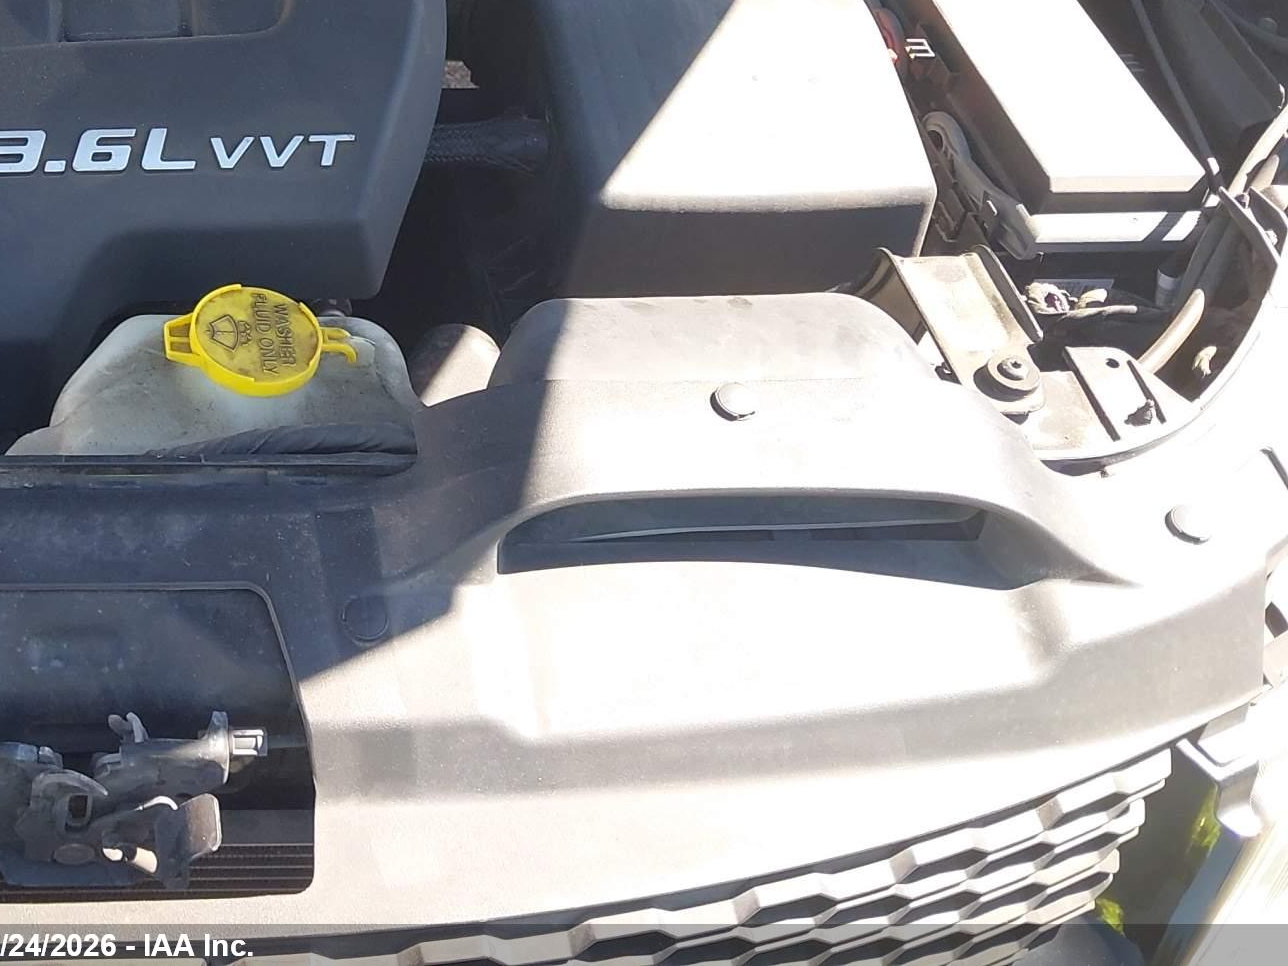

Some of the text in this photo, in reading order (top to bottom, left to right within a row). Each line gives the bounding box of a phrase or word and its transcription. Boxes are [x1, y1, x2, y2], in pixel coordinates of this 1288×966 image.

[210, 134, 355, 169] VVT
[253, 293, 279, 375] FLUID ONLY
[273, 303, 296, 367] WASHER
